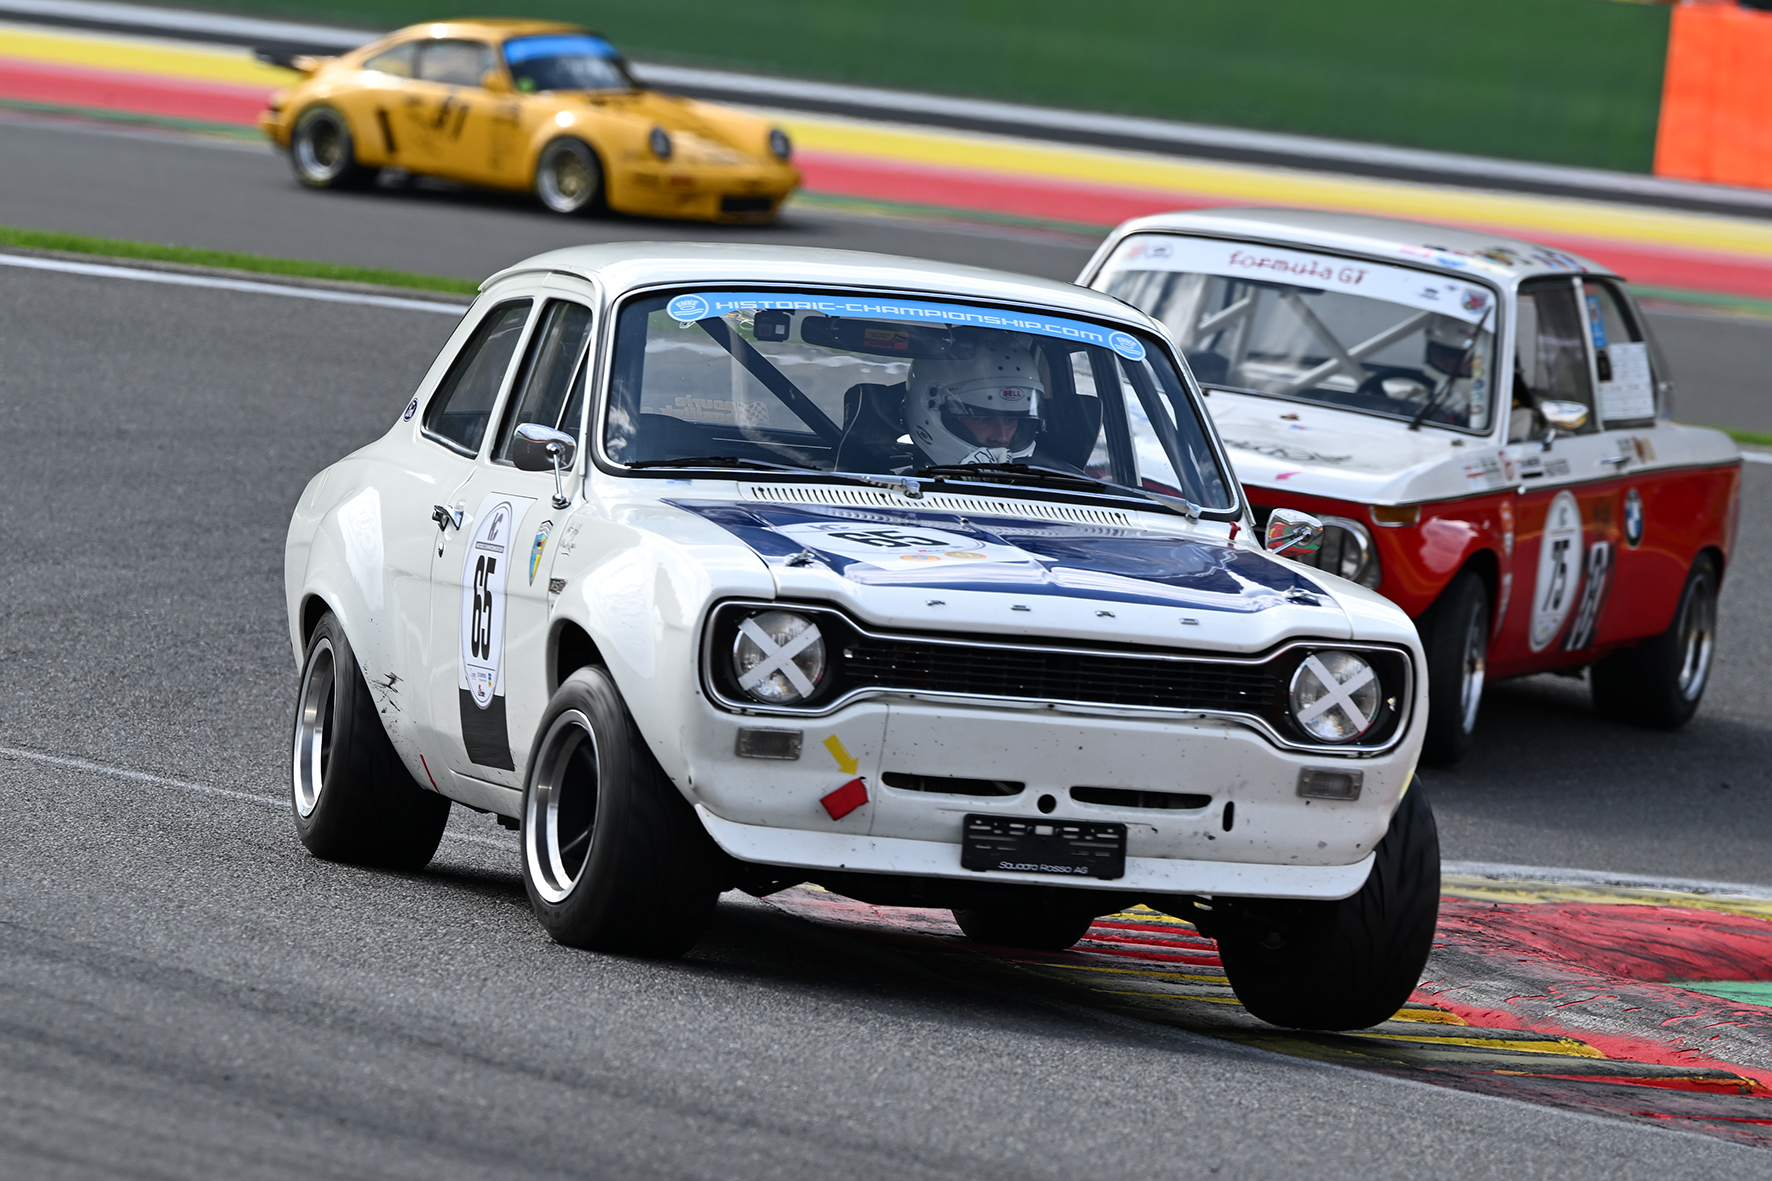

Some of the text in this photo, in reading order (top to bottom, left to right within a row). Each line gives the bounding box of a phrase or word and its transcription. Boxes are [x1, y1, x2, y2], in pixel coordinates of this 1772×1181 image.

[1229, 249, 1369, 285] formula GT
[675, 299, 700, 308] ENKE
[827, 530, 950, 548] 65
[1541, 539, 1570, 613] 75
[471, 554, 497, 661] 65
[1073, 866, 1089, 875] AG
